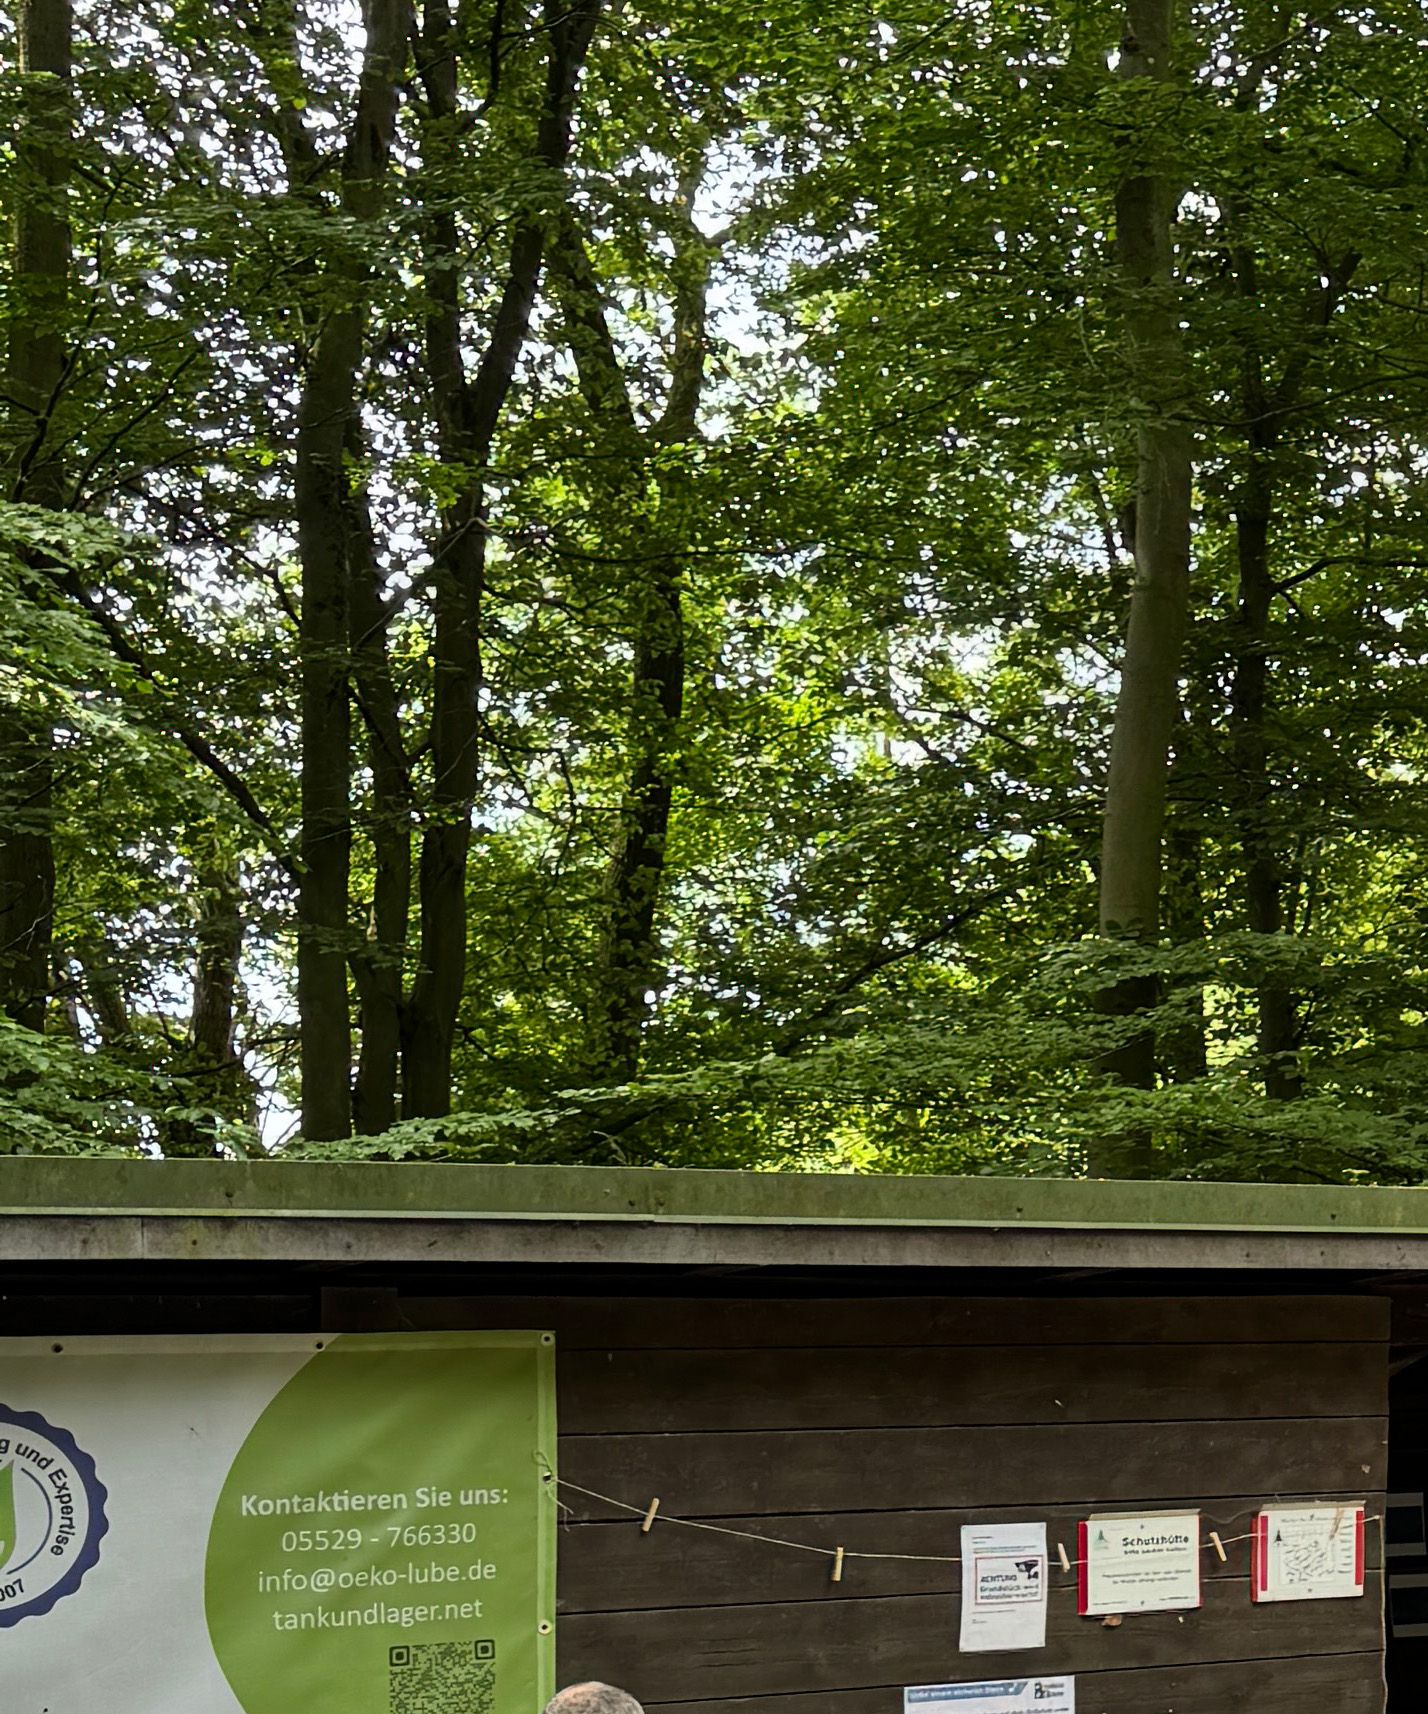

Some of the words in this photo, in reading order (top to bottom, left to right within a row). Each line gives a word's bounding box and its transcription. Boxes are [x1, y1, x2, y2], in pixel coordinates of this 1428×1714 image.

[15, 1443, 54, 1471] und
[48, 1468, 76, 1556] Expertise
[241, 1489, 408, 1517] Kontaktieren
[415, 1486, 452, 1508] Sie
[459, 1487, 509, 1506] uns:
[282, 1528, 362, 1552] 05529
[387, 1523, 477, 1548] 766330
[258, 1559, 497, 1593] info@oeko-lube.de
[273, 1600, 483, 1631] tankundlager.net
